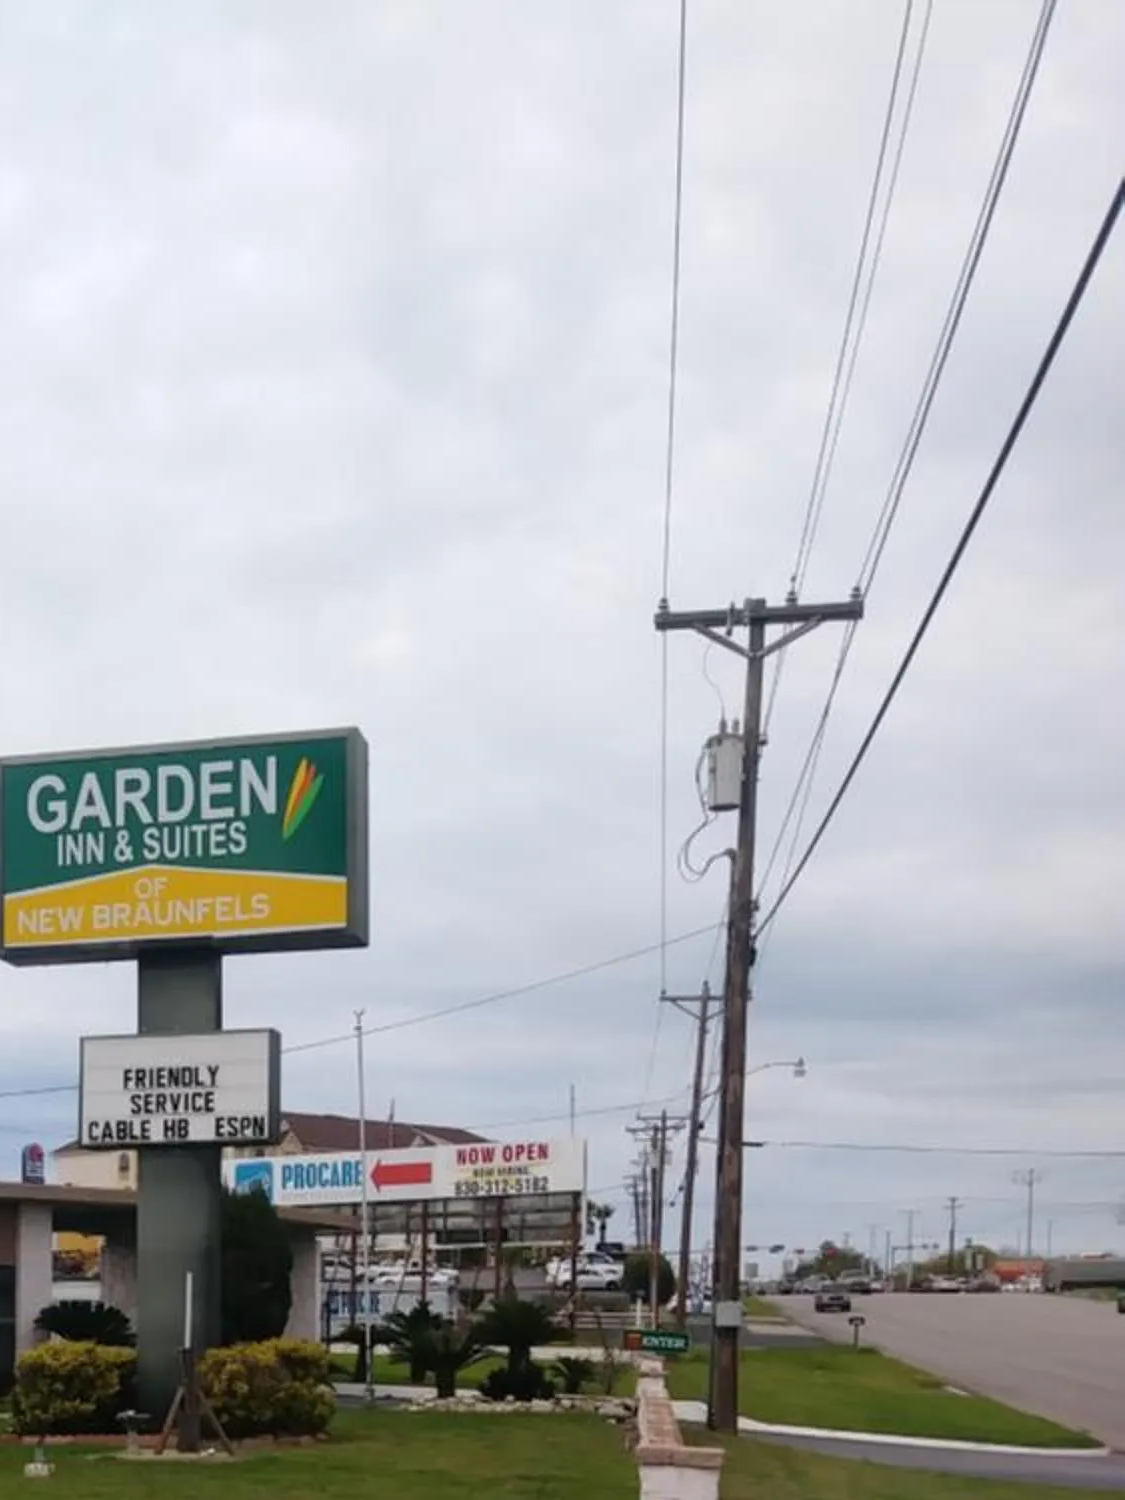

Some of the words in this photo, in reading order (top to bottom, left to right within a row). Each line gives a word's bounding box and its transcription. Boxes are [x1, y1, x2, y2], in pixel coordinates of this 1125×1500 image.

[27, 756, 277, 833] GARDEN
[58, 831, 103, 866] INN
[114, 831, 134, 862] &
[143, 821, 247, 860] SUITES
[134, 877, 168, 900] OF
[17, 907, 83, 934] NEW
[92, 894, 271, 930] BRAUNFELS
[123, 1065, 219, 1090] FRIENDLY
[130, 1091, 215, 1115] SERVICE
[88, 1119, 151, 1142] CABLE
[163, 1118, 190, 1140] HB
[215, 1115, 265, 1138] ESPN
[456, 1146, 495, 1167] NOW
[502, 1142, 549, 1163] OPEN
[282, 1160, 364, 1190] PROCARE
